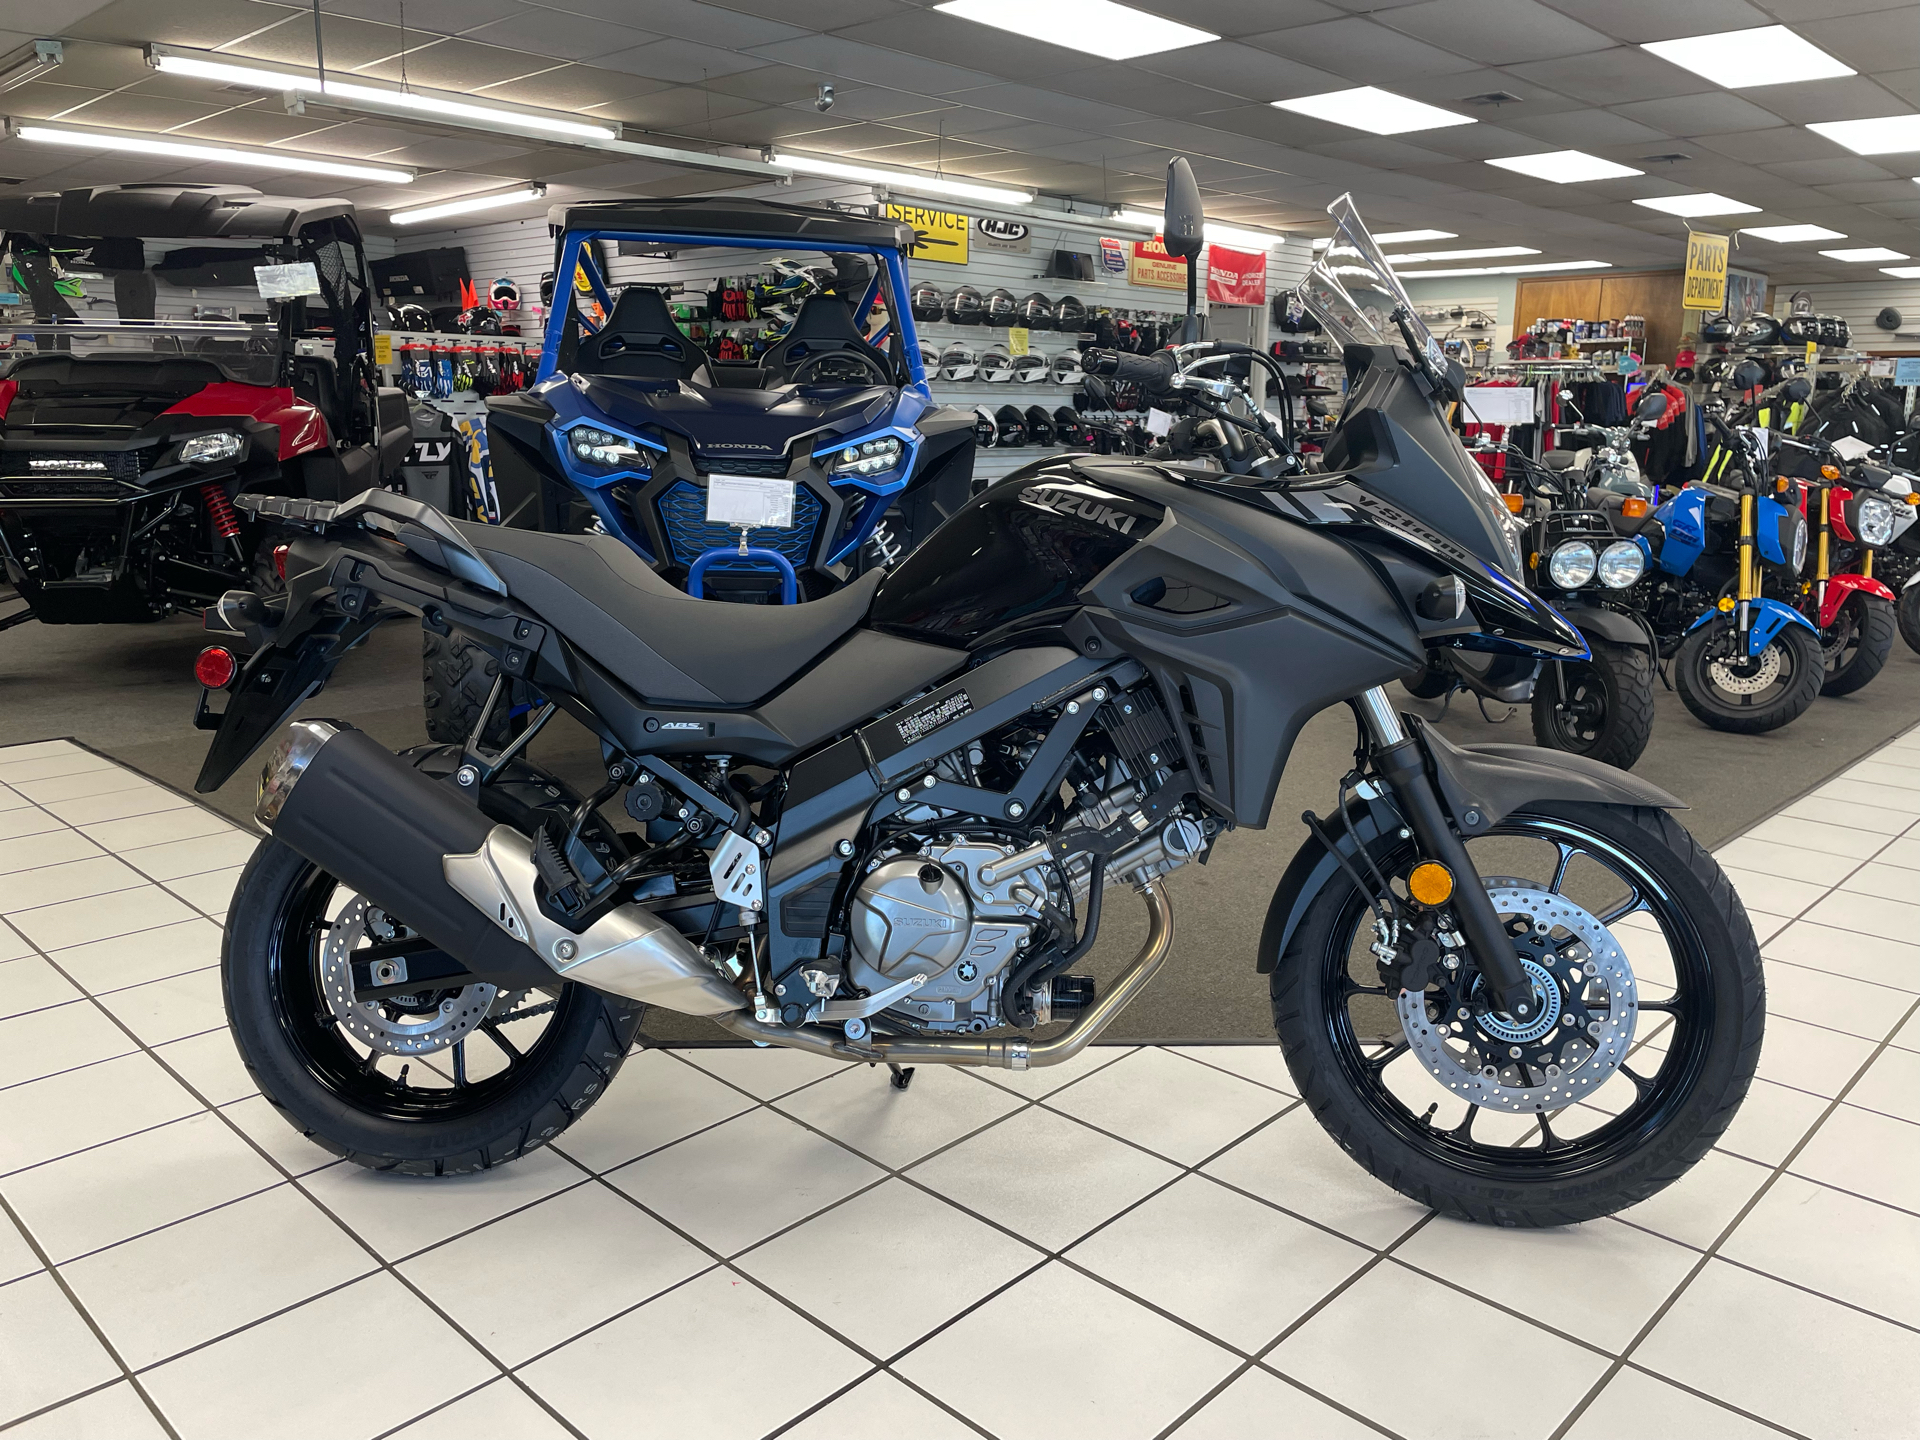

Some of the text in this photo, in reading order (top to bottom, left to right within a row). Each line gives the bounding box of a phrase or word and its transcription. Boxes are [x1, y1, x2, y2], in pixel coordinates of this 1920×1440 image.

[891, 204, 965, 231] SERVICE
[985, 219, 1021, 236] HJC
[1142, 241, 1168, 254] HON
[1689, 242, 1725, 273] PARTS
[1152, 262, 1177, 270] GENUINE
[1210, 266, 1239, 279] HONDA
[1137, 268, 1187, 284] PARTS ACCESSORIE
[1687, 276, 1723, 300] DEPARTMENT
[404, 442, 452, 462] FLY
[707, 443, 774, 451] HONDA
[29, 460, 107, 470] HONDA
[1017, 486, 1137, 535] SUZUKI
[661, 722, 701, 730] ABS
[893, 917, 947, 929] SUZUKI
